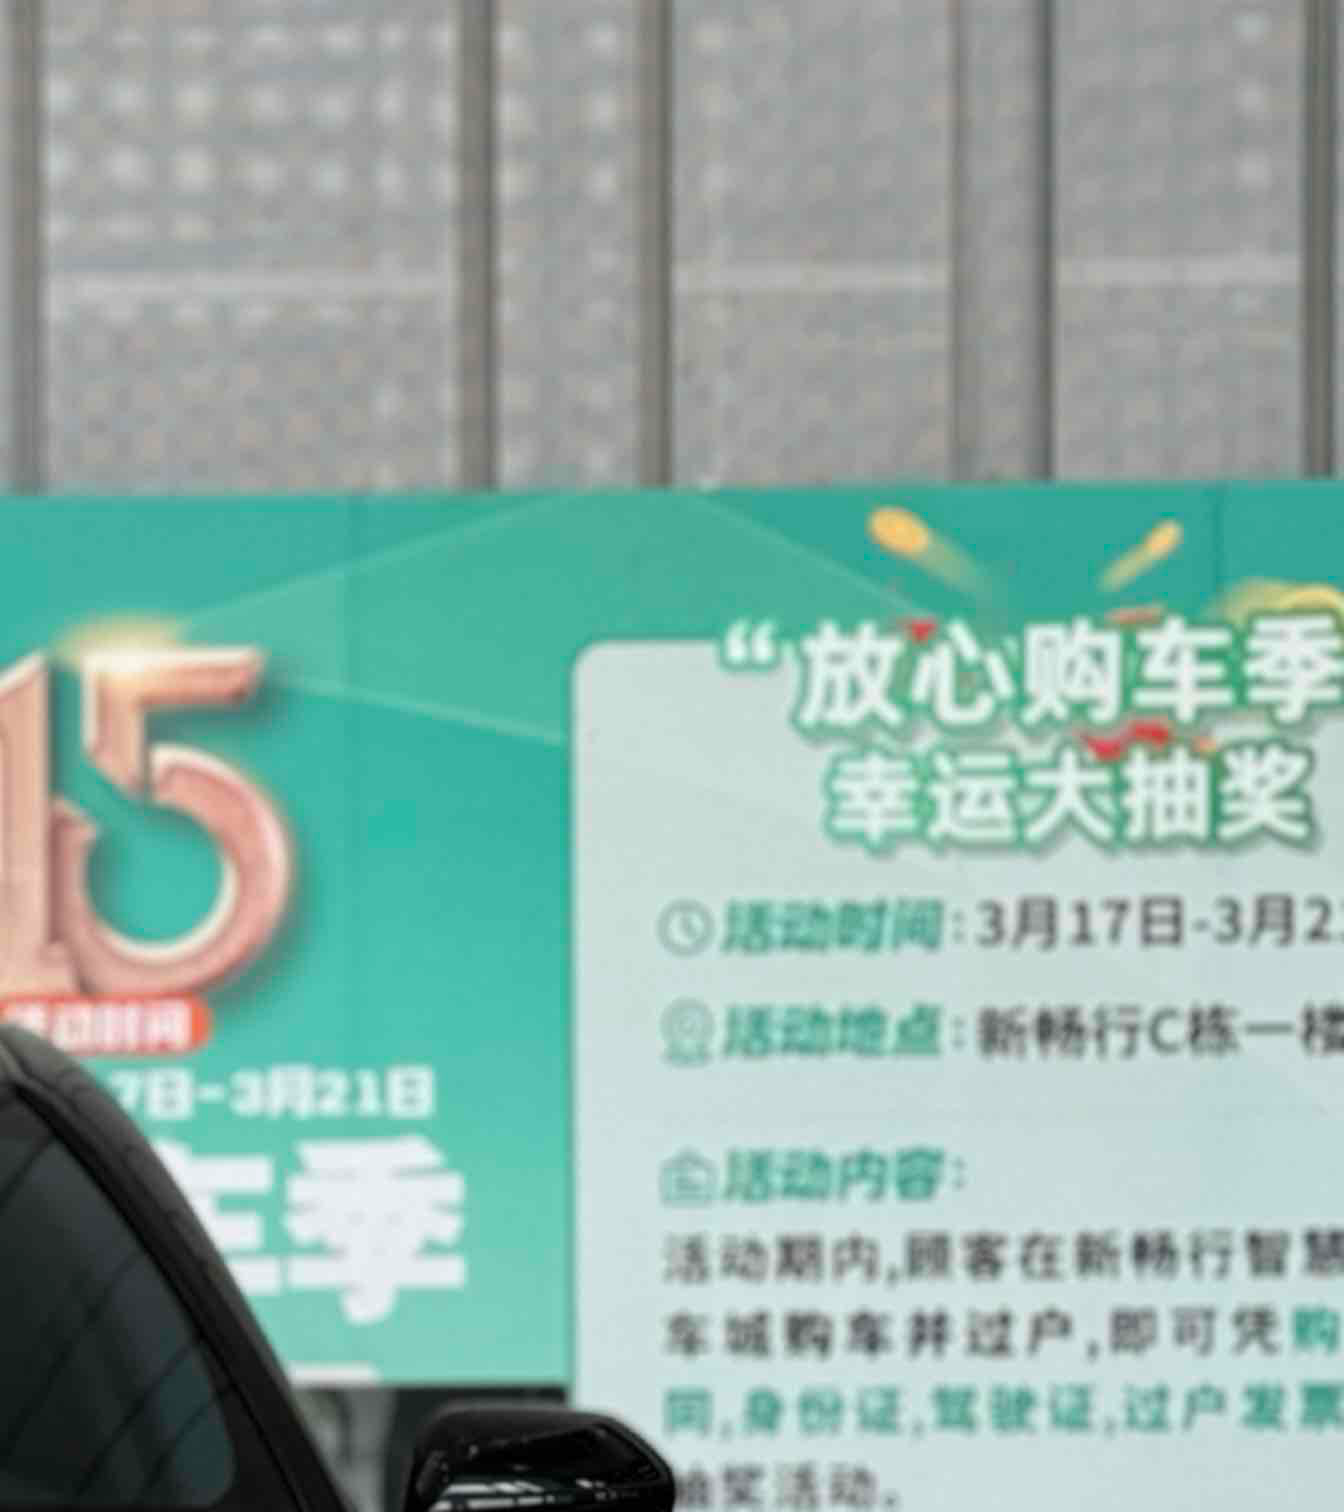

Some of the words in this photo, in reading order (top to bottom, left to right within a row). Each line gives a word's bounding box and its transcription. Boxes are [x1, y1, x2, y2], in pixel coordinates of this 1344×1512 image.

[724, 616, 1344, 730] “放心购车季
[830, 745, 1312, 844] 幸运大抽奖
